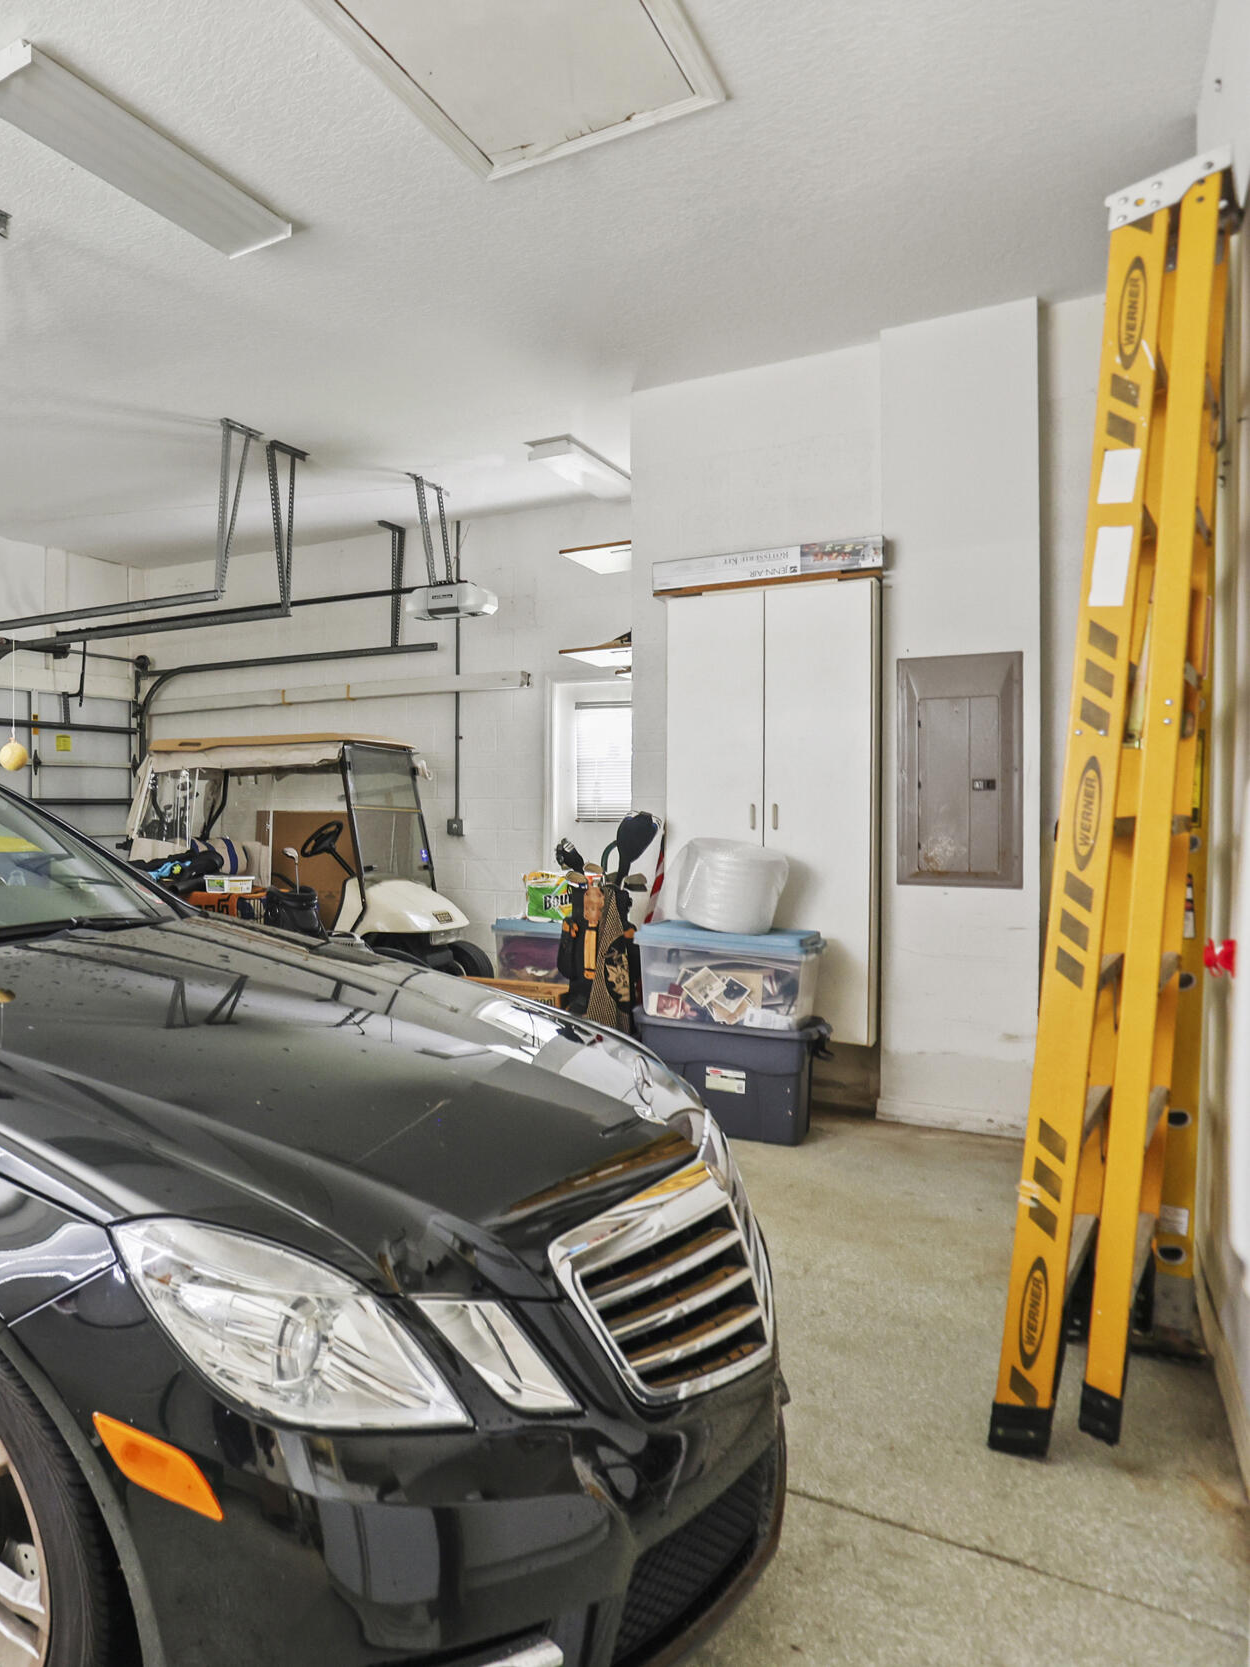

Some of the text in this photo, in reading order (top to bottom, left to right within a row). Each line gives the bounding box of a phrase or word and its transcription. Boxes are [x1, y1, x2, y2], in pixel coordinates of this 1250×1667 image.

[1124, 278, 1141, 346] WERNER
[1078, 777, 1097, 846] WERNER
[543, 894, 570, 911] Bou
[1025, 1277, 1043, 1346] WERNER
